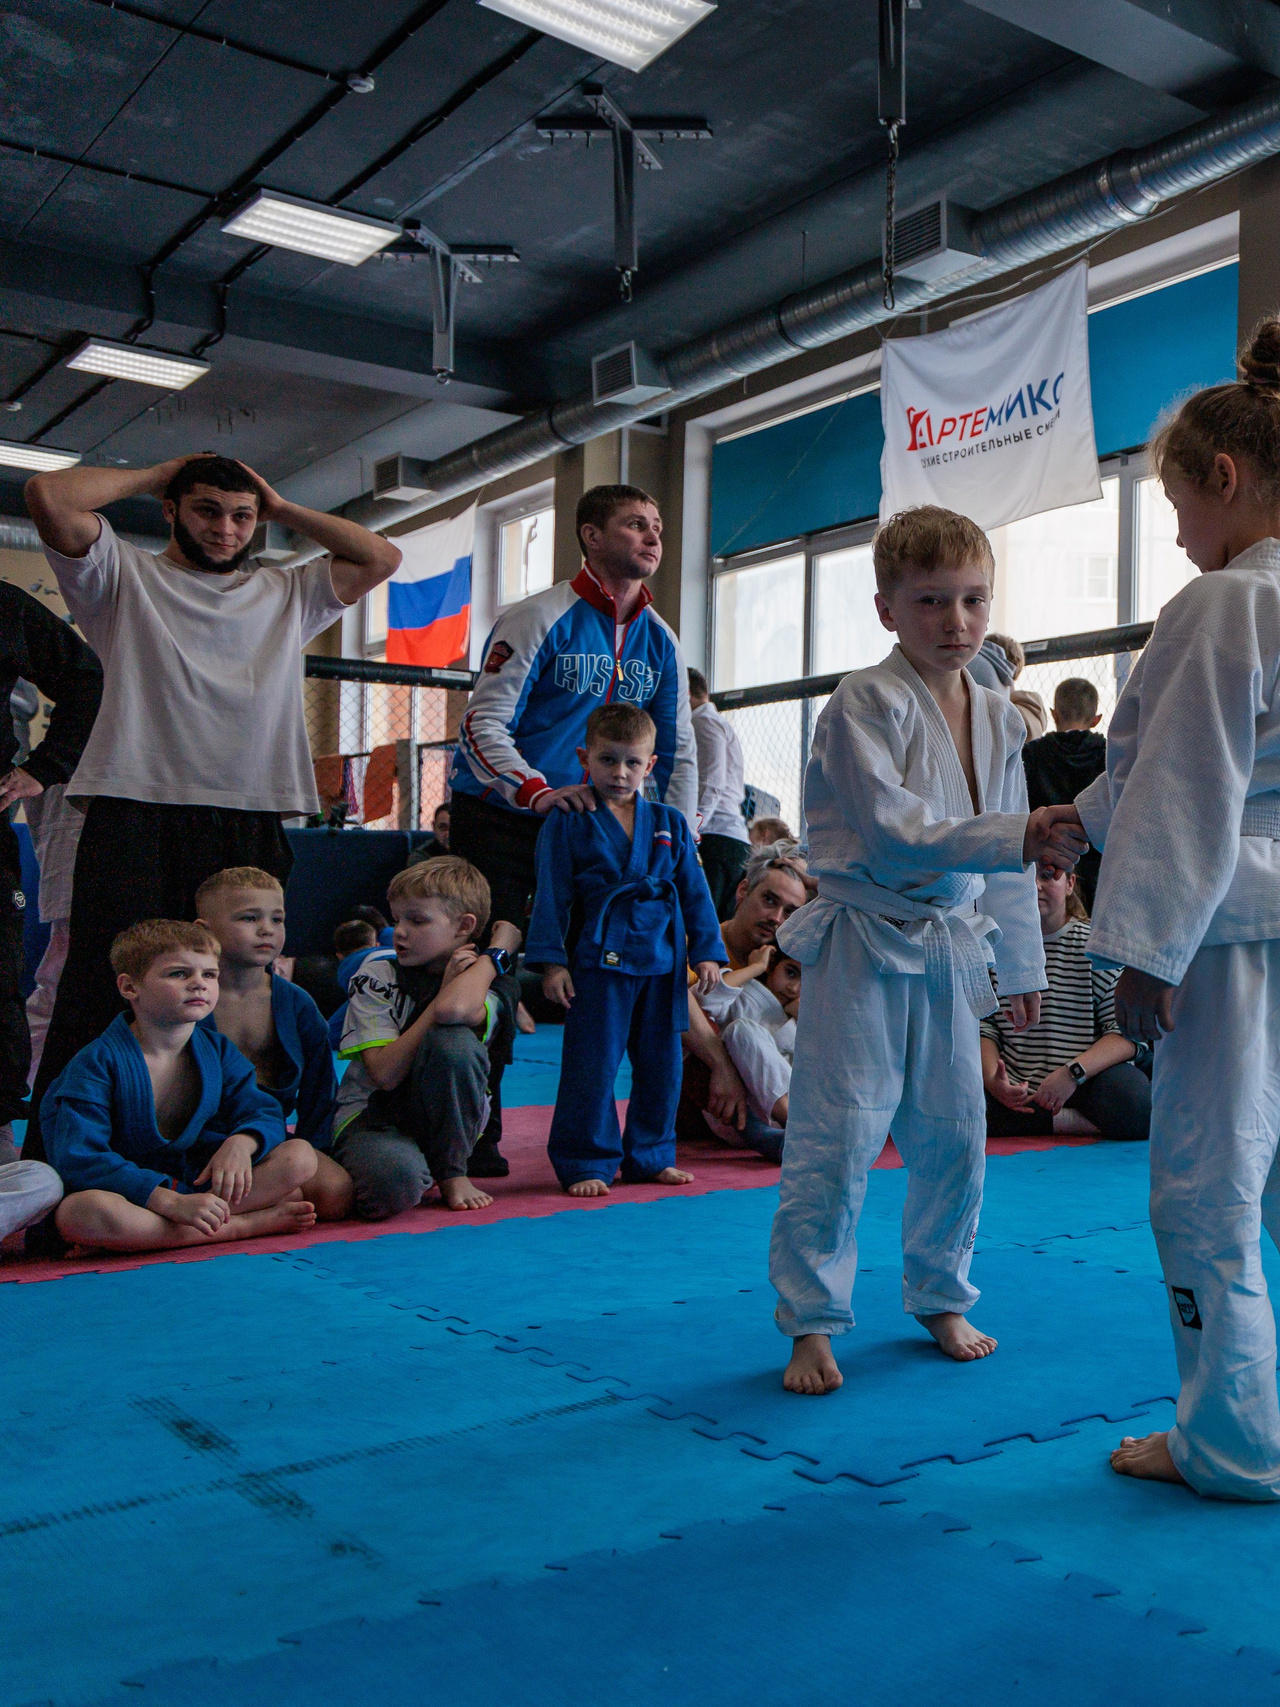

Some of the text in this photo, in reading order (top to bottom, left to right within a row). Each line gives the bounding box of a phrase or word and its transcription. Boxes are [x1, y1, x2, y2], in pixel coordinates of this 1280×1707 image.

[921, 408, 1060, 468] УХИЕ СТРОИТЕЛЬНЫЕ СМЕИ
[554, 653, 662, 702] RUSS
